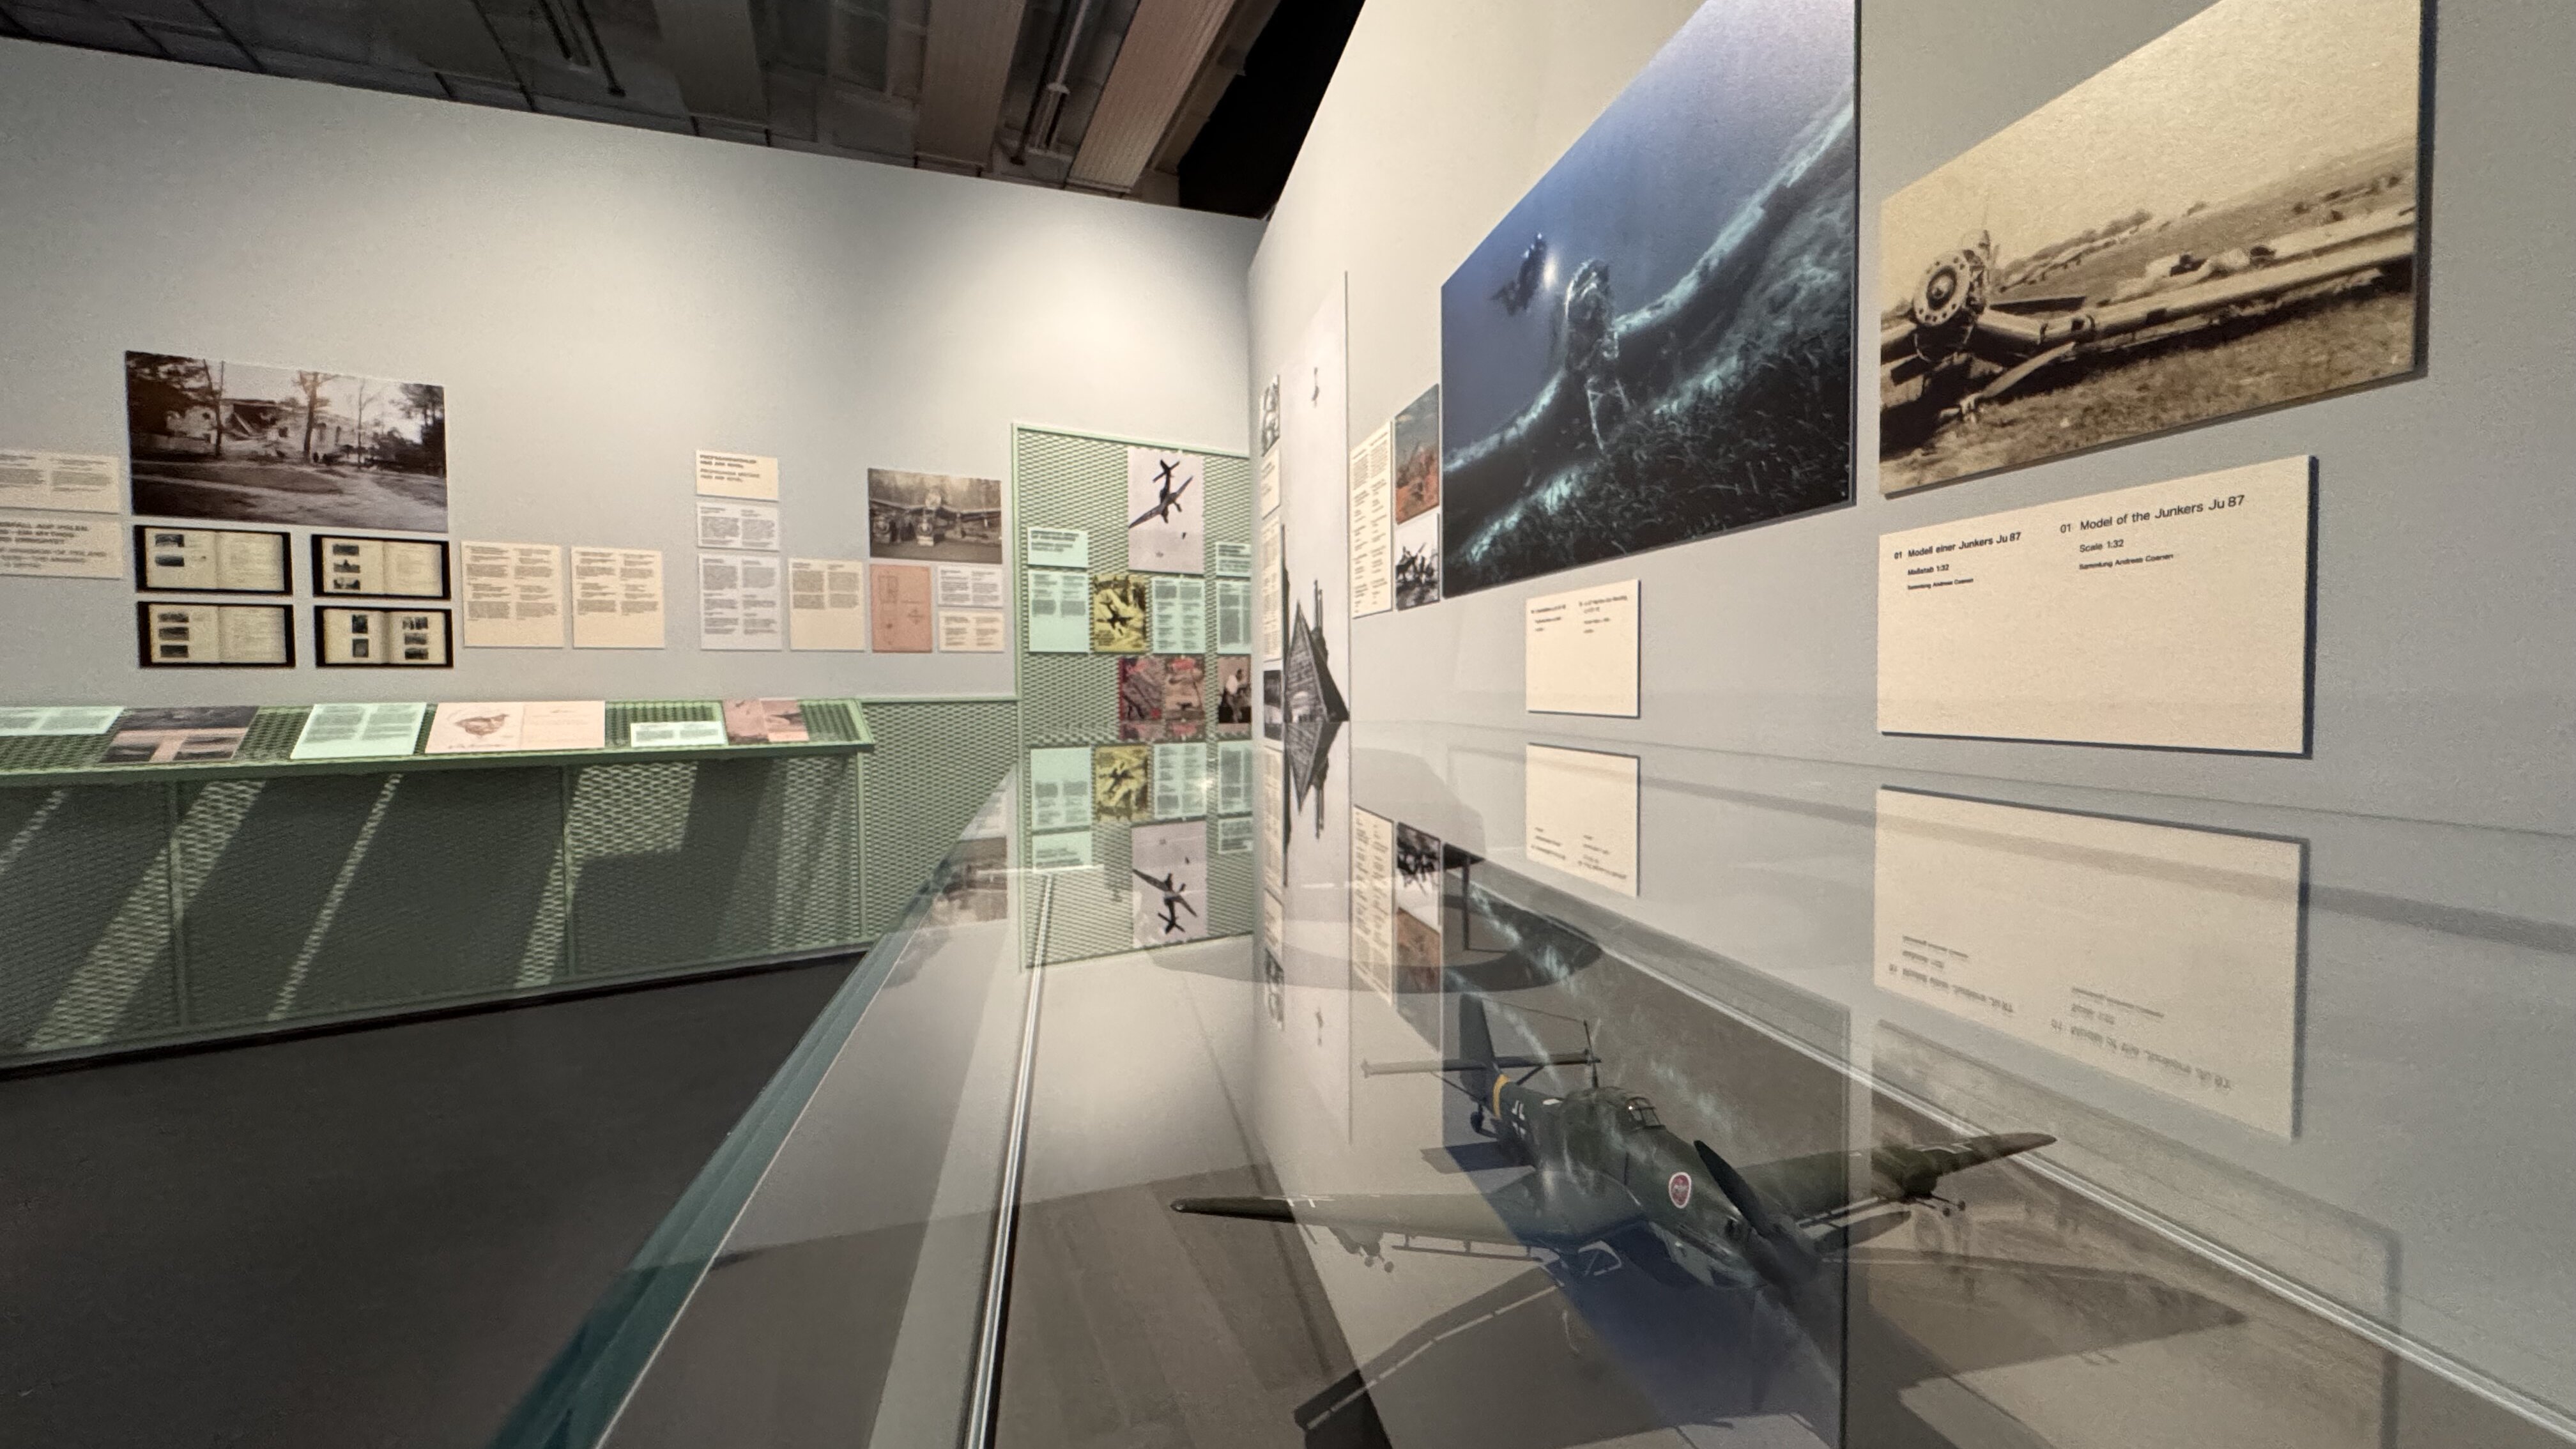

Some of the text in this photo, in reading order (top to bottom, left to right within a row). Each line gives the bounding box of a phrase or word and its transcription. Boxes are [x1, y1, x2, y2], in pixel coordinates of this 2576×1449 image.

[2060, 494, 2245, 533] 01 Model of the Junkers Ju 87
[1908, 546, 1933, 557] Modell
[1936, 544, 1956, 553] einer
[1959, 537, 1993, 549] Junkers
[1997, 535, 2007, 543] Ju
[2009, 532, 2021, 541] 87
[2080, 539, 2124, 553] Scale 1:32
